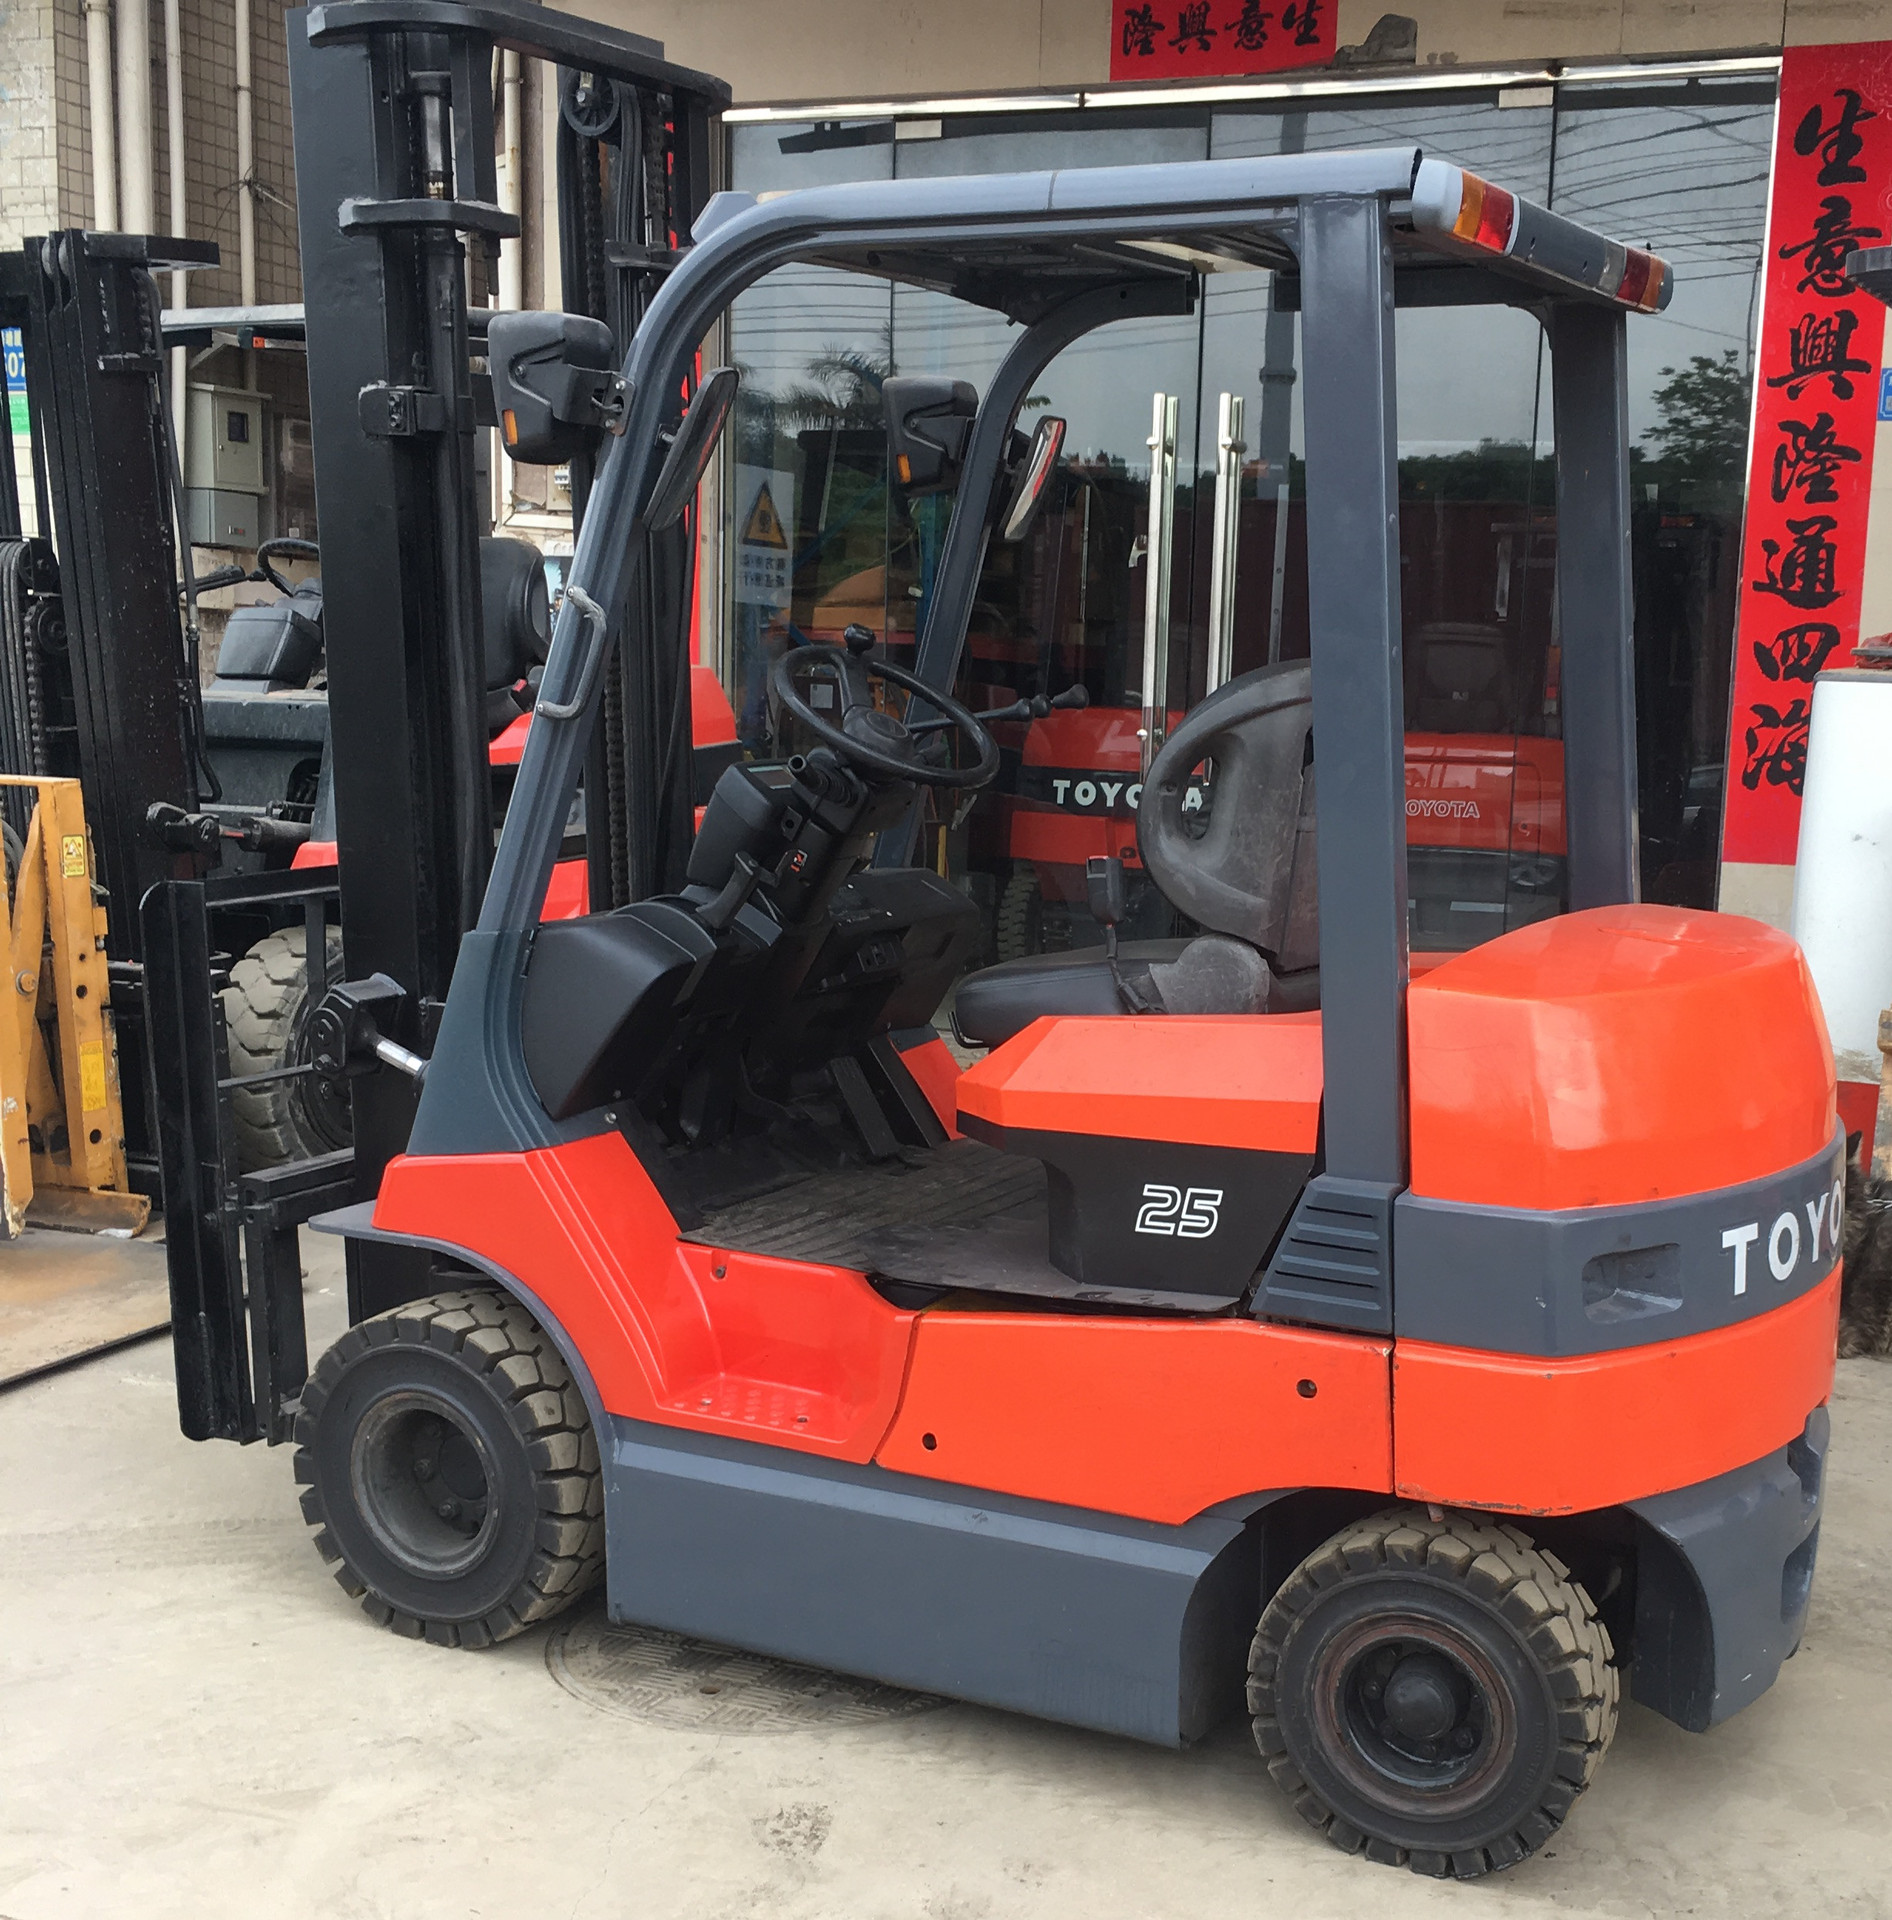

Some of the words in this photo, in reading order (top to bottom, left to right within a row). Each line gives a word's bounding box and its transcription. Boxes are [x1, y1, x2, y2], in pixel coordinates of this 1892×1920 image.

[1053, 779, 1203, 812] TOYOA
[1135, 1184, 1224, 1239] 25
[1722, 1179, 1842, 1296] TOYO
